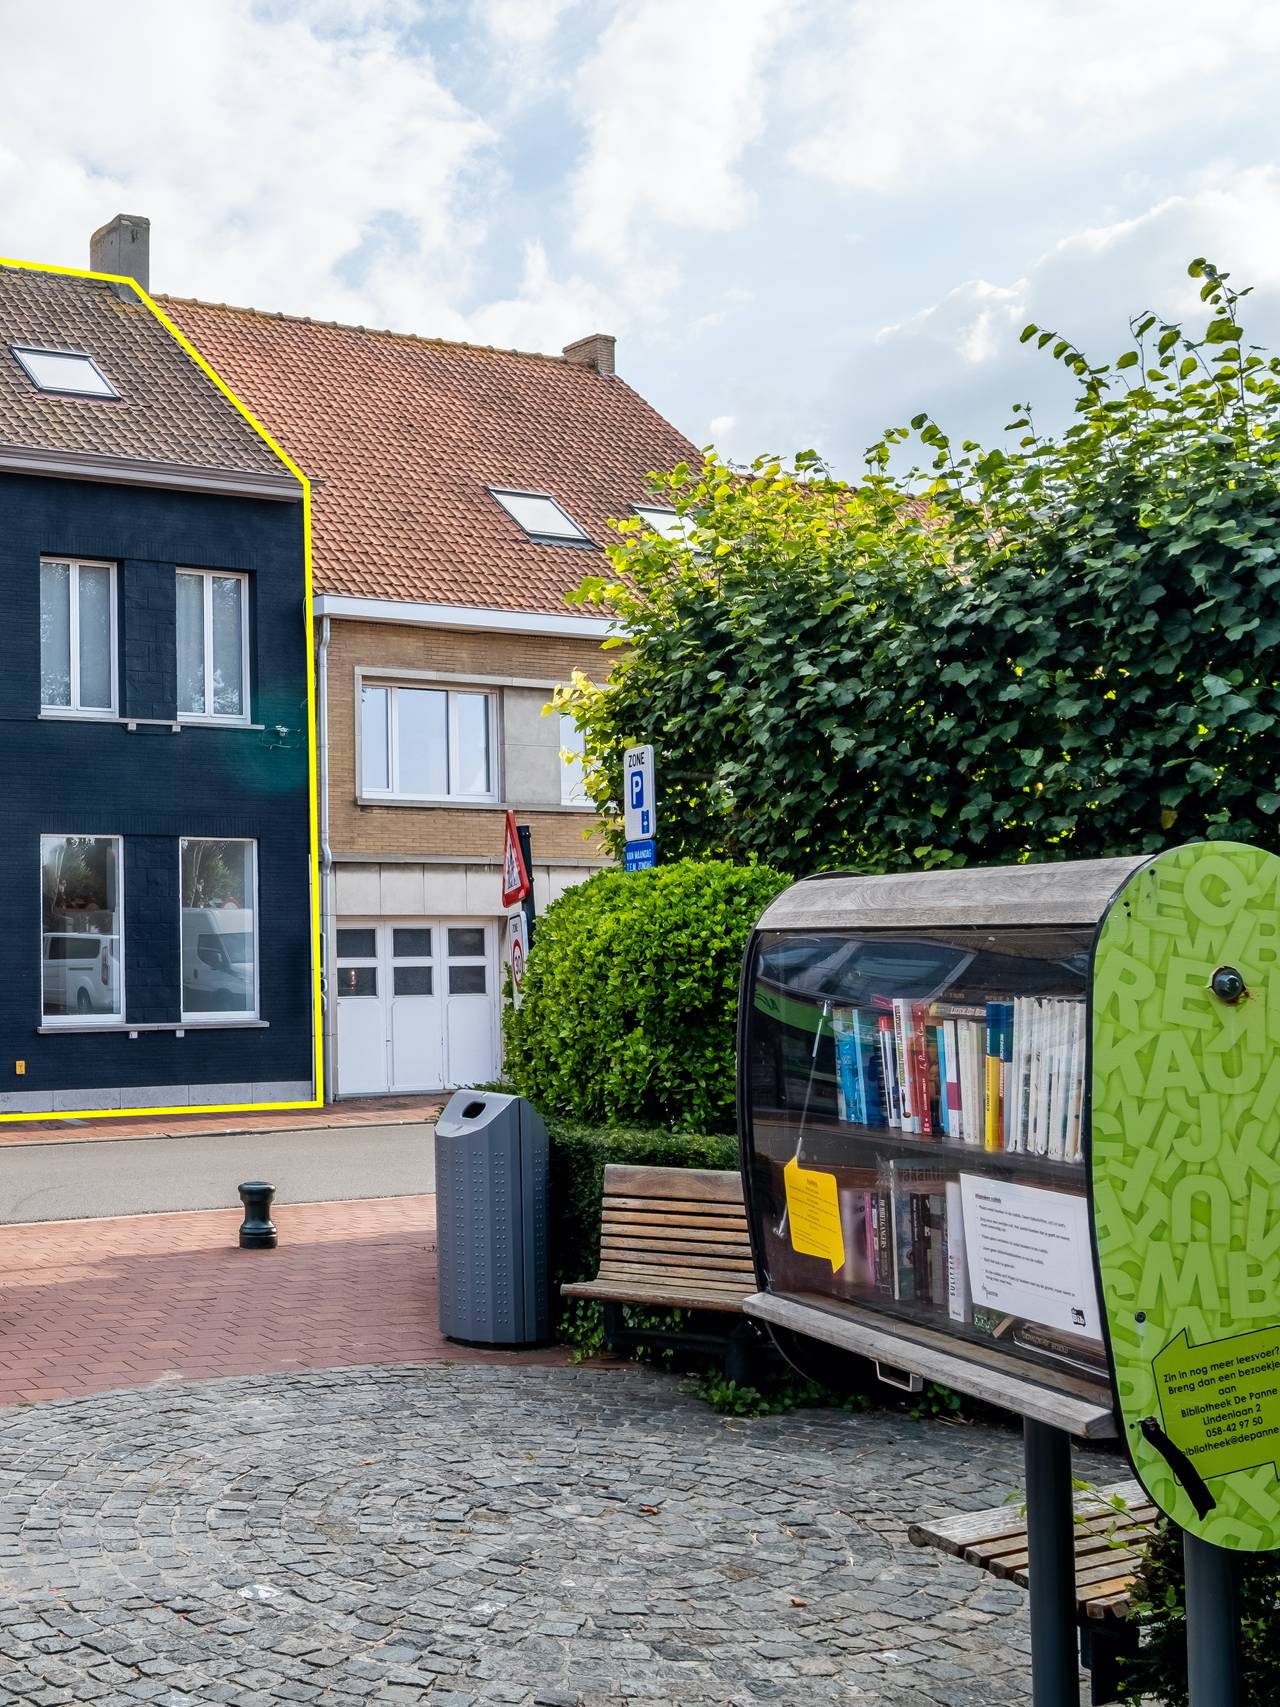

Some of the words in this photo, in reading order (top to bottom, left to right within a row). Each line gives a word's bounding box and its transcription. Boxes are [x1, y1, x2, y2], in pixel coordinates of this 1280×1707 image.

[628, 752, 645, 768] ZONE
[632, 775, 642, 805] P
[1163, 1373, 1177, 1383] Zin
[1178, 1370, 1187, 1379] in
[1189, 1366, 1208, 1376] nog
[1210, 1359, 1235, 1372] meer
[1236, 1346, 1280, 1364] leesvoer?
[1168, 1382, 1196, 1395] Breng
[1197, 1376, 1216, 1388] dan
[1218, 1372, 1236, 1382] een
[1238, 1360, 1280, 1378] bezoekje
[1181, 1398, 1232, 1418] Bibliotheek
[1234, 1395, 1247, 1405] De
[1248, 1388, 1278, 1401] Panne
[1218, 1385, 1237, 1396] aan
[1203, 1406, 1254, 1426] Lindenlaan
[1255, 1403, 1262, 1413] 2
[1205, 1422, 1237, 1438] 058-42
[1239, 1419, 1250, 1429] 97
[1252, 1416, 1263, 1426] 50
